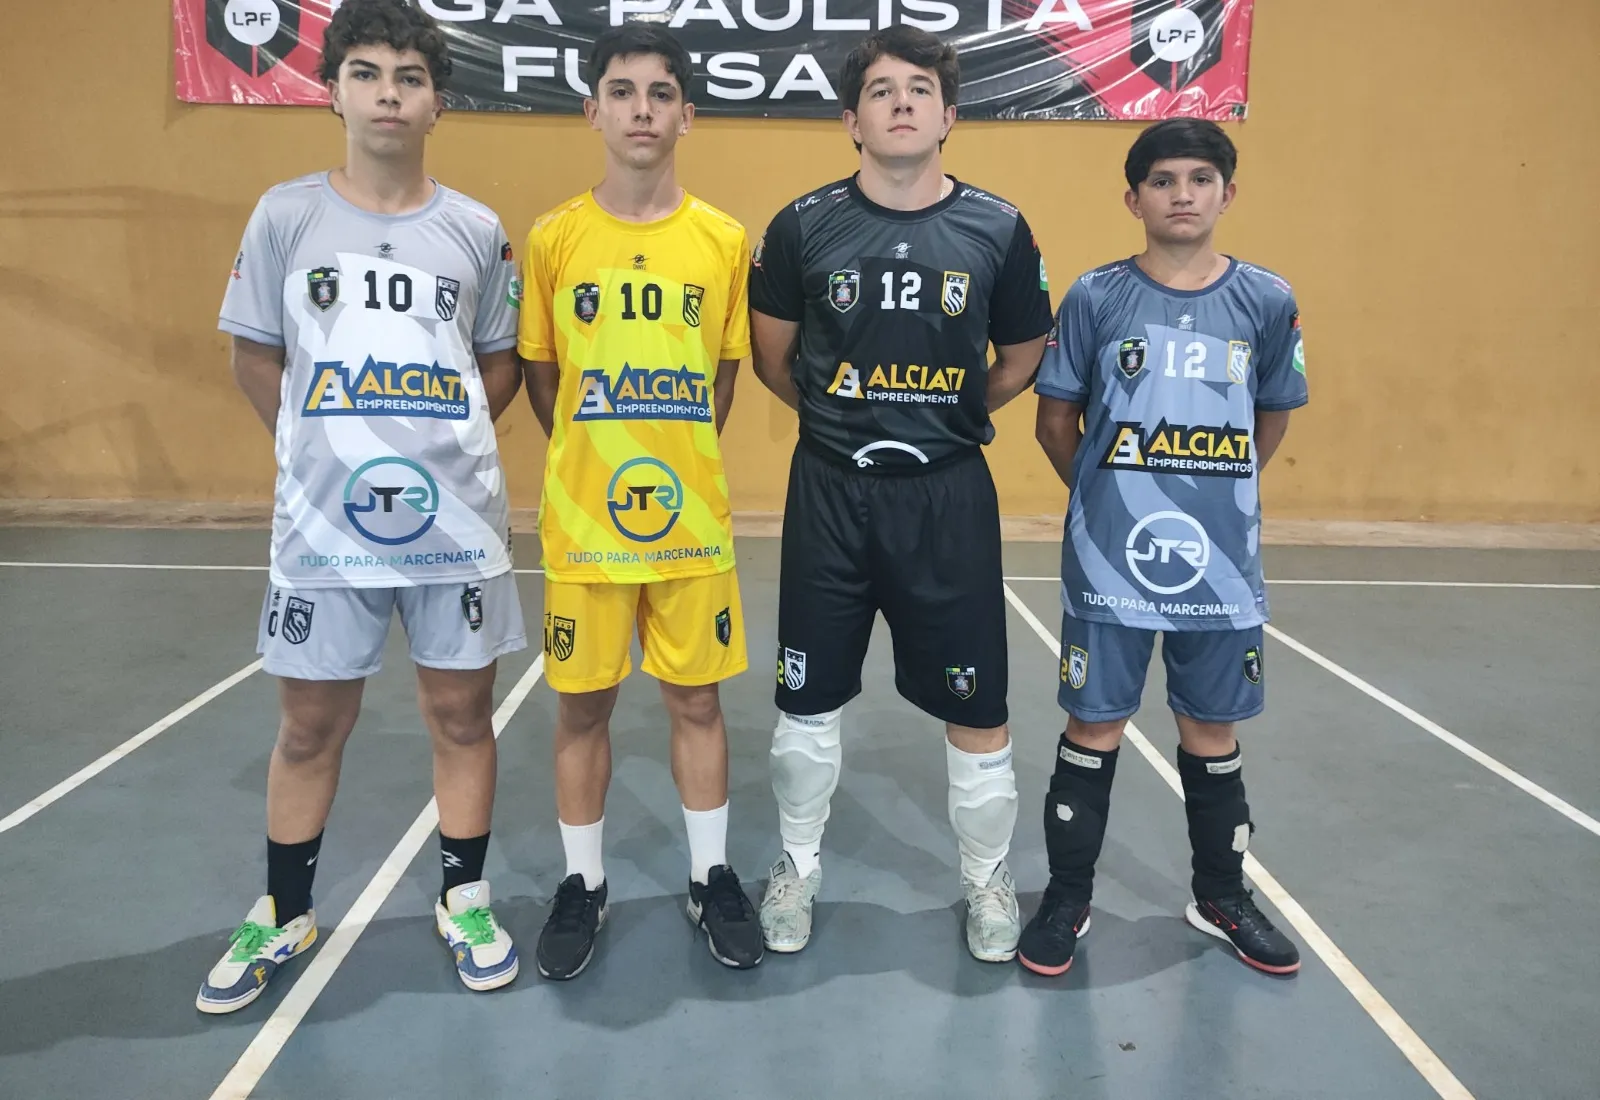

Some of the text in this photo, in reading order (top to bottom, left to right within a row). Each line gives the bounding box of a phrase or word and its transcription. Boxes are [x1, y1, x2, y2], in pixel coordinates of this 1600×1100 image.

[232, 11, 272, 26] LPF
[1156, 28, 1196, 44] LPF
[364, 270, 413, 312] 10
[620, 282, 663, 321] 10
[880, 271, 922, 311] 12
[1163, 340, 1207, 379] 12
[356, 369, 466, 402] ALCIATI
[616, 375, 706, 404] ALCIAT
[866, 363, 966, 392] ALCIATI
[355, 398, 466, 415] EMPREENDIMENTOS
[1146, 456, 1253, 473] EMPREENDIMENTOS
[298, 548, 486, 568] TUDO PARA MARCENARIA
[566, 545, 721, 564] TUDO PARA MARCENARIA
[1081, 591, 1240, 616] TUDO PARA MARCENARIA
